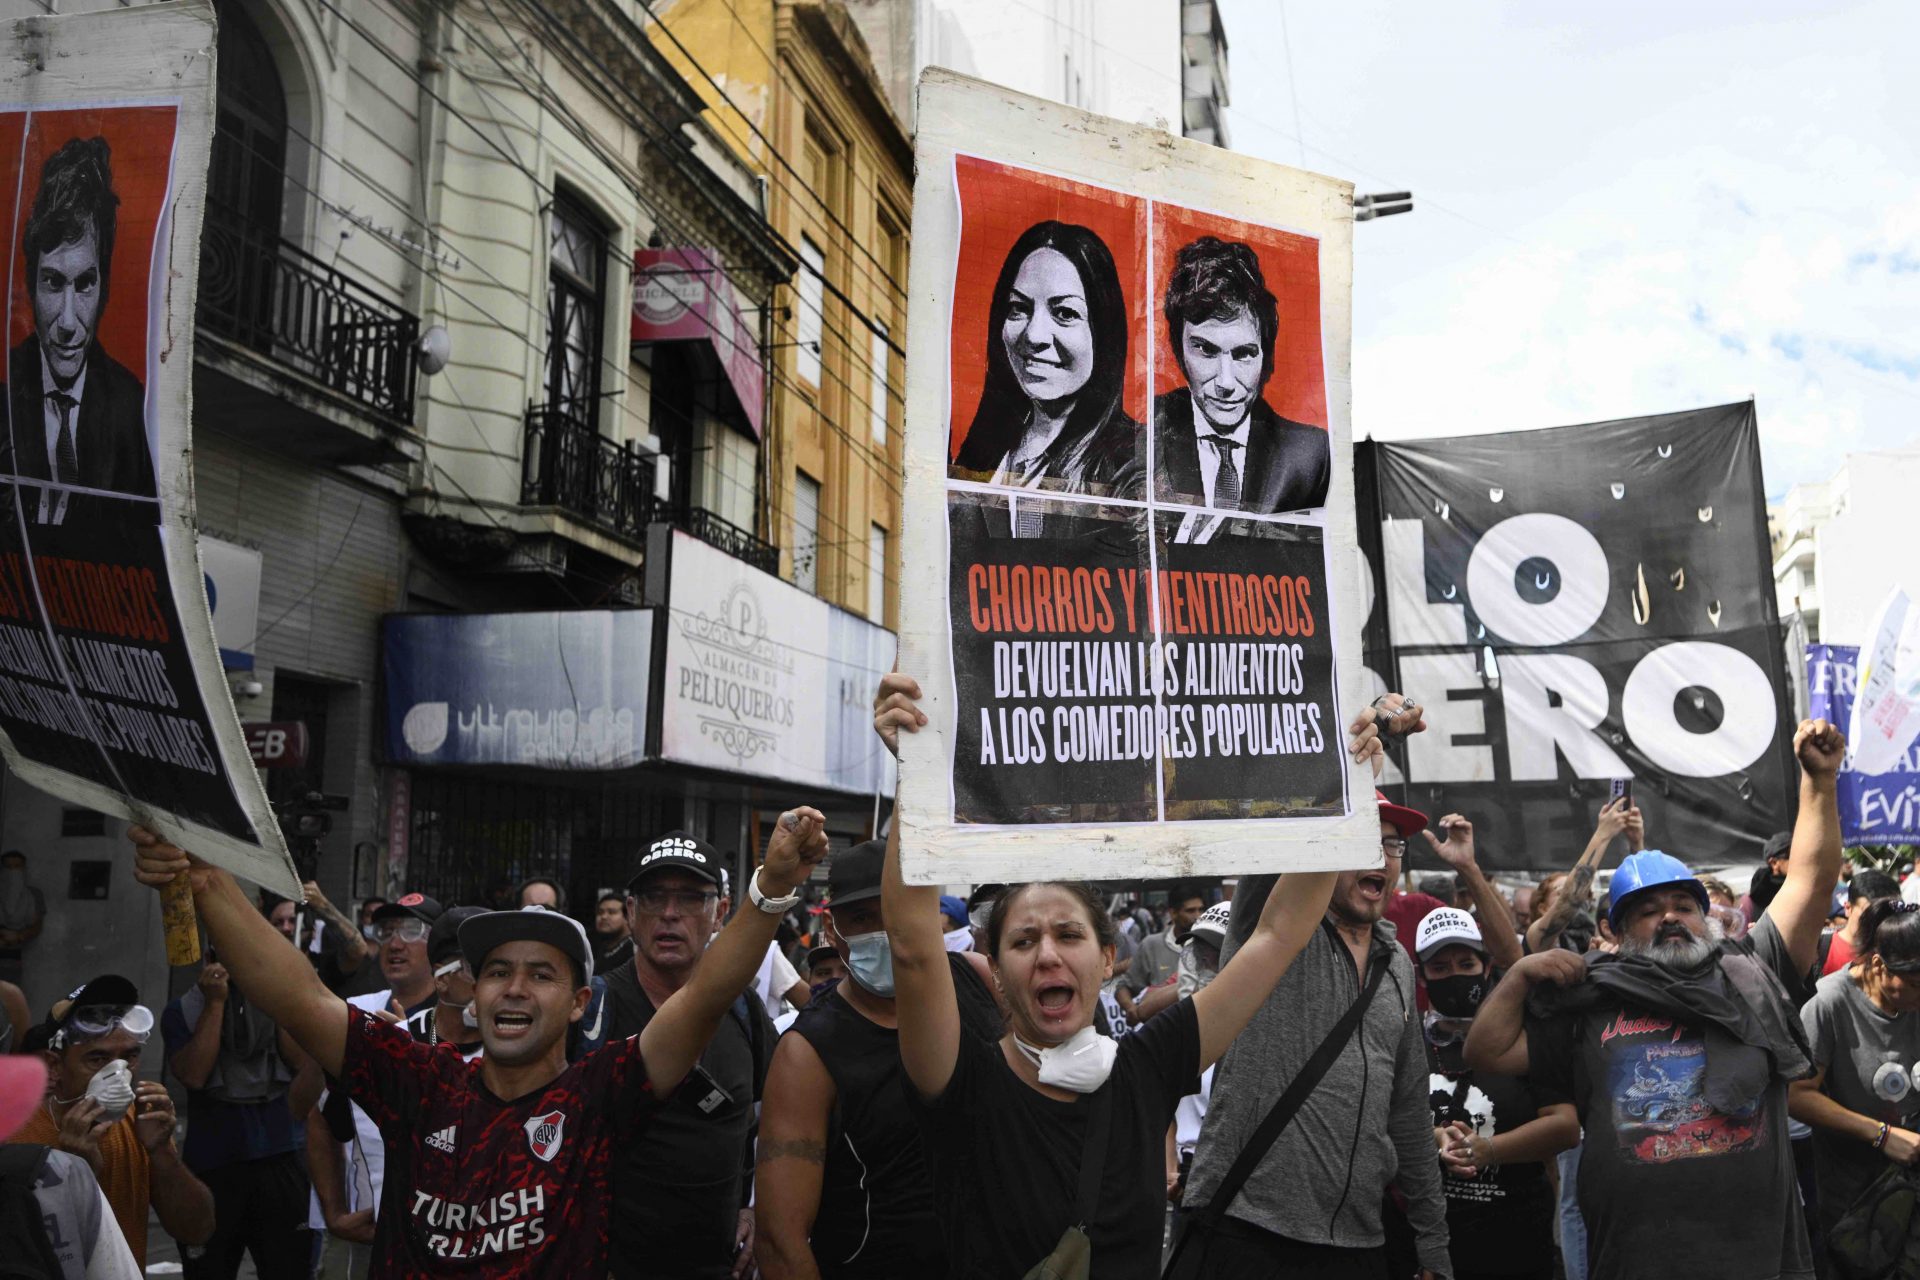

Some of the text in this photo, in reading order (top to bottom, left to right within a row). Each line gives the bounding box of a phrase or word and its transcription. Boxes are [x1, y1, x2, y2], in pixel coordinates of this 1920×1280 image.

[968, 564, 1315, 638] CHORROS Y MENTIROSOS
[1357, 513, 1610, 648] LO
[71, 636, 179, 709] ALIMENTOS
[679, 665, 794, 728] PELUQUEROS
[703, 651, 777, 689] ALMACÉN DE
[994, 641, 1304, 699] DEVUELVAN LOS ALIMENTOS
[105, 701, 217, 776] POPULARES
[980, 701, 1325, 766] A LOS COMEDORES POPULARES
[1363, 641, 1777, 787] ERO
[640, 847, 707, 866] OBRERO
[650, 837, 697, 853] POLO
[1424, 920, 1468, 935] OBRERO
[1428, 912, 1459, 925] POLO
[425, 1136, 456, 1154] adidas
[411, 1184, 545, 1231] TURKISH
